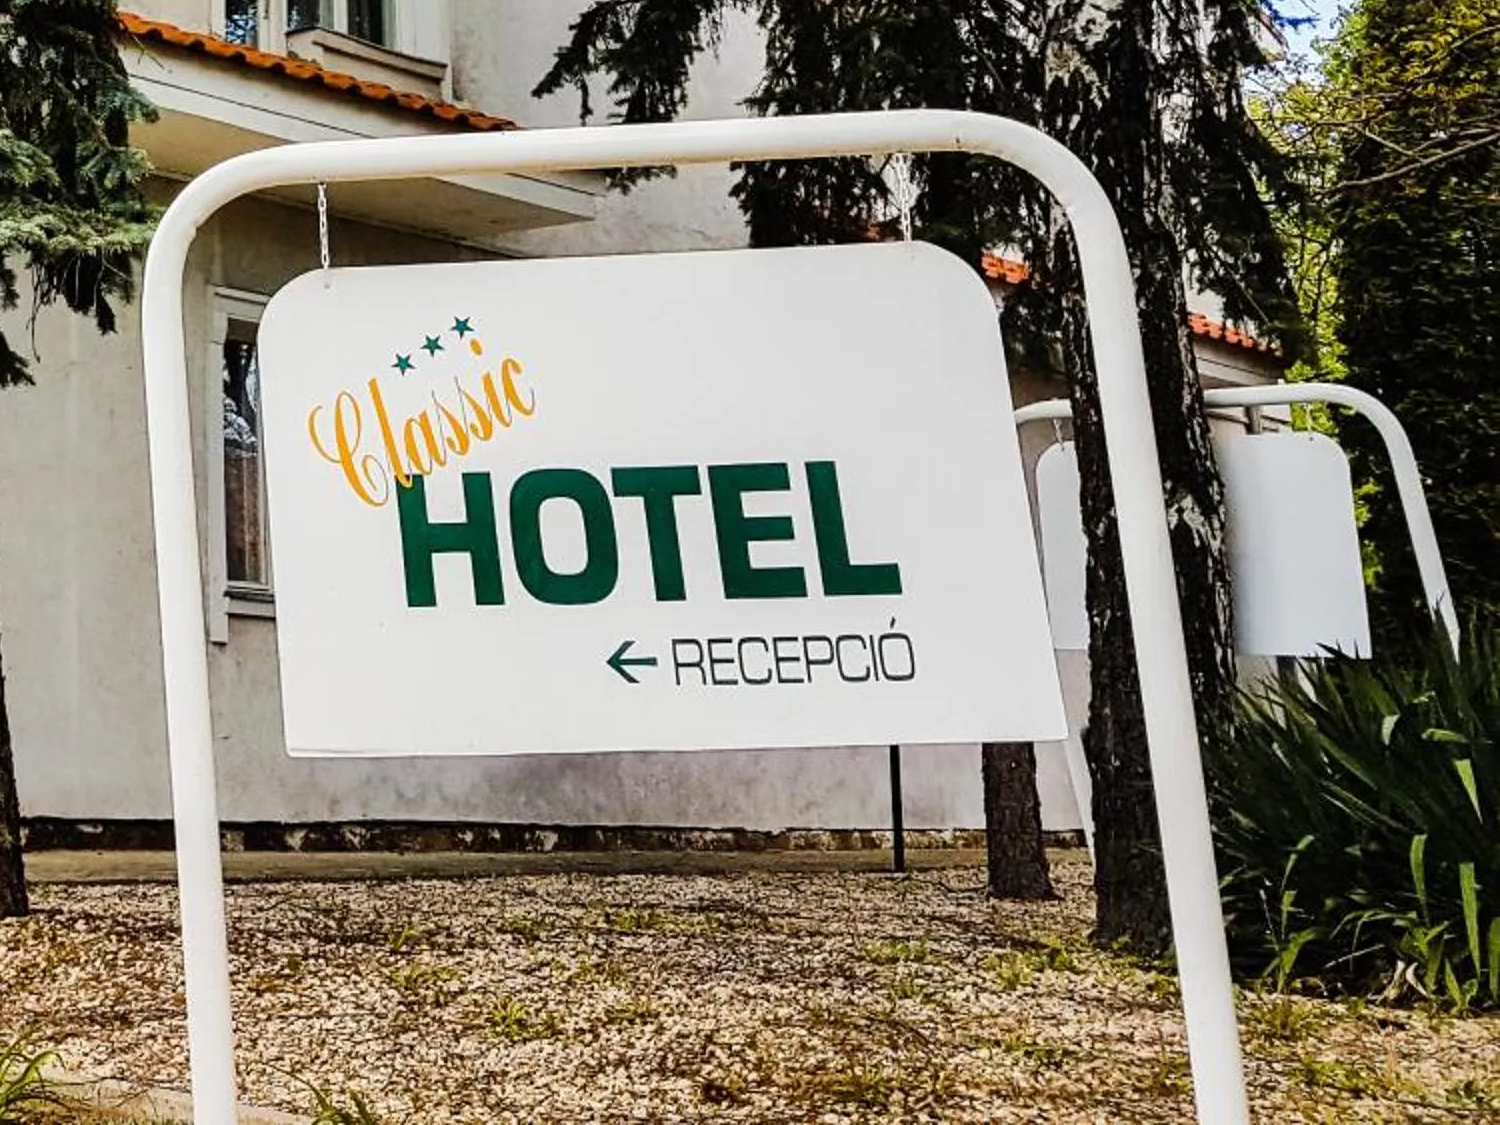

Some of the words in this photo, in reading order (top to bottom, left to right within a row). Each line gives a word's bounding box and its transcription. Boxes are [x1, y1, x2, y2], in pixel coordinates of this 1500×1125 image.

[307, 338, 535, 508] Classic
[397, 461, 901, 608] HOTEL
[671, 616, 916, 687] RECEPCIÓ
